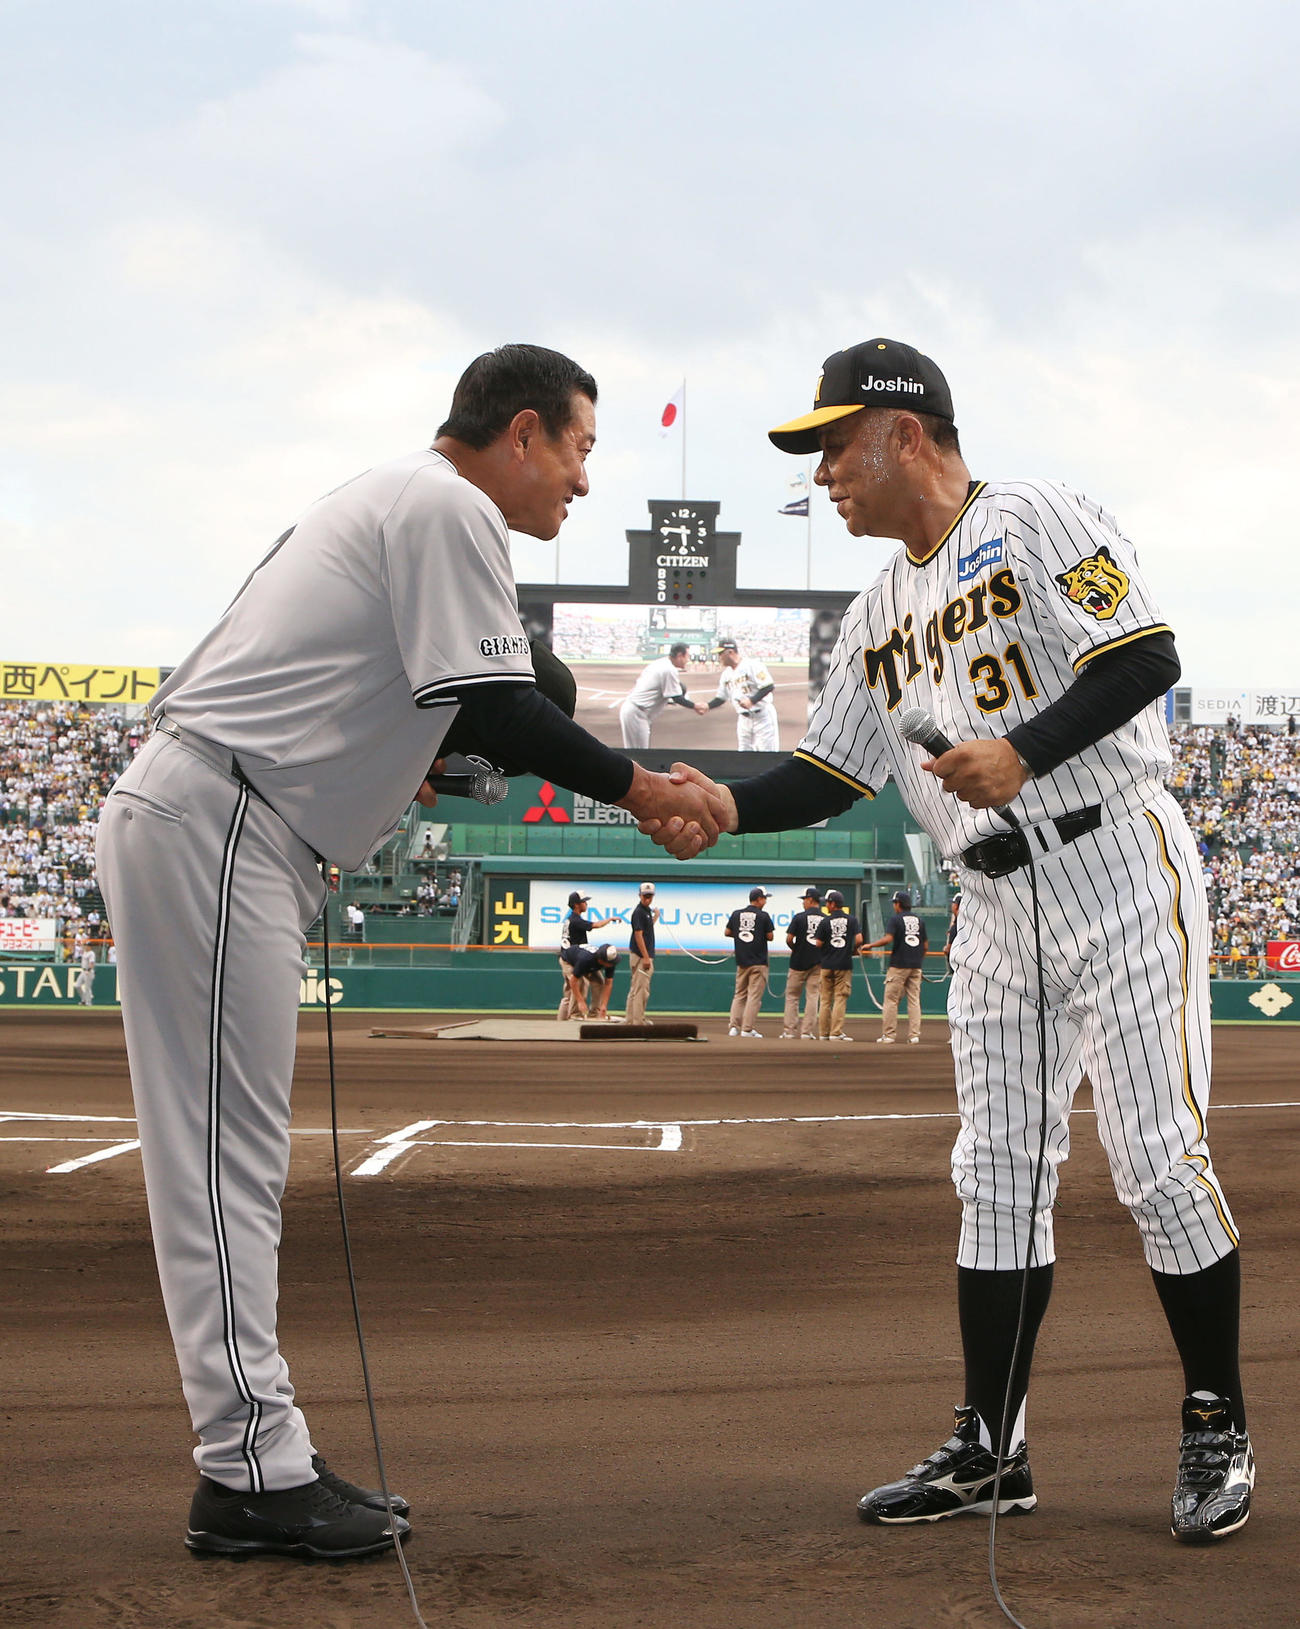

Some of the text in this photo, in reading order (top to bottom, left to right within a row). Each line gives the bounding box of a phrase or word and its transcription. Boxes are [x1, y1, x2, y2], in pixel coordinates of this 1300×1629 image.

[861, 375, 924, 394] Joshin
[679, 508, 690, 518] 12
[698, 527, 707, 537] 3
[657, 555, 709, 567] CITIZEN
[959, 545, 1001, 577] Joshin
[658, 568, 667, 579] B
[657, 580, 666, 591] S
[479, 635, 529, 657] GIANTS
[863, 567, 1023, 712] Tigers
[3, 665, 155, 700] 西ペイント
[968, 641, 1039, 714] 31
[1198, 700, 1241, 710] SEDIA
[494, 892, 524, 944] 山九
